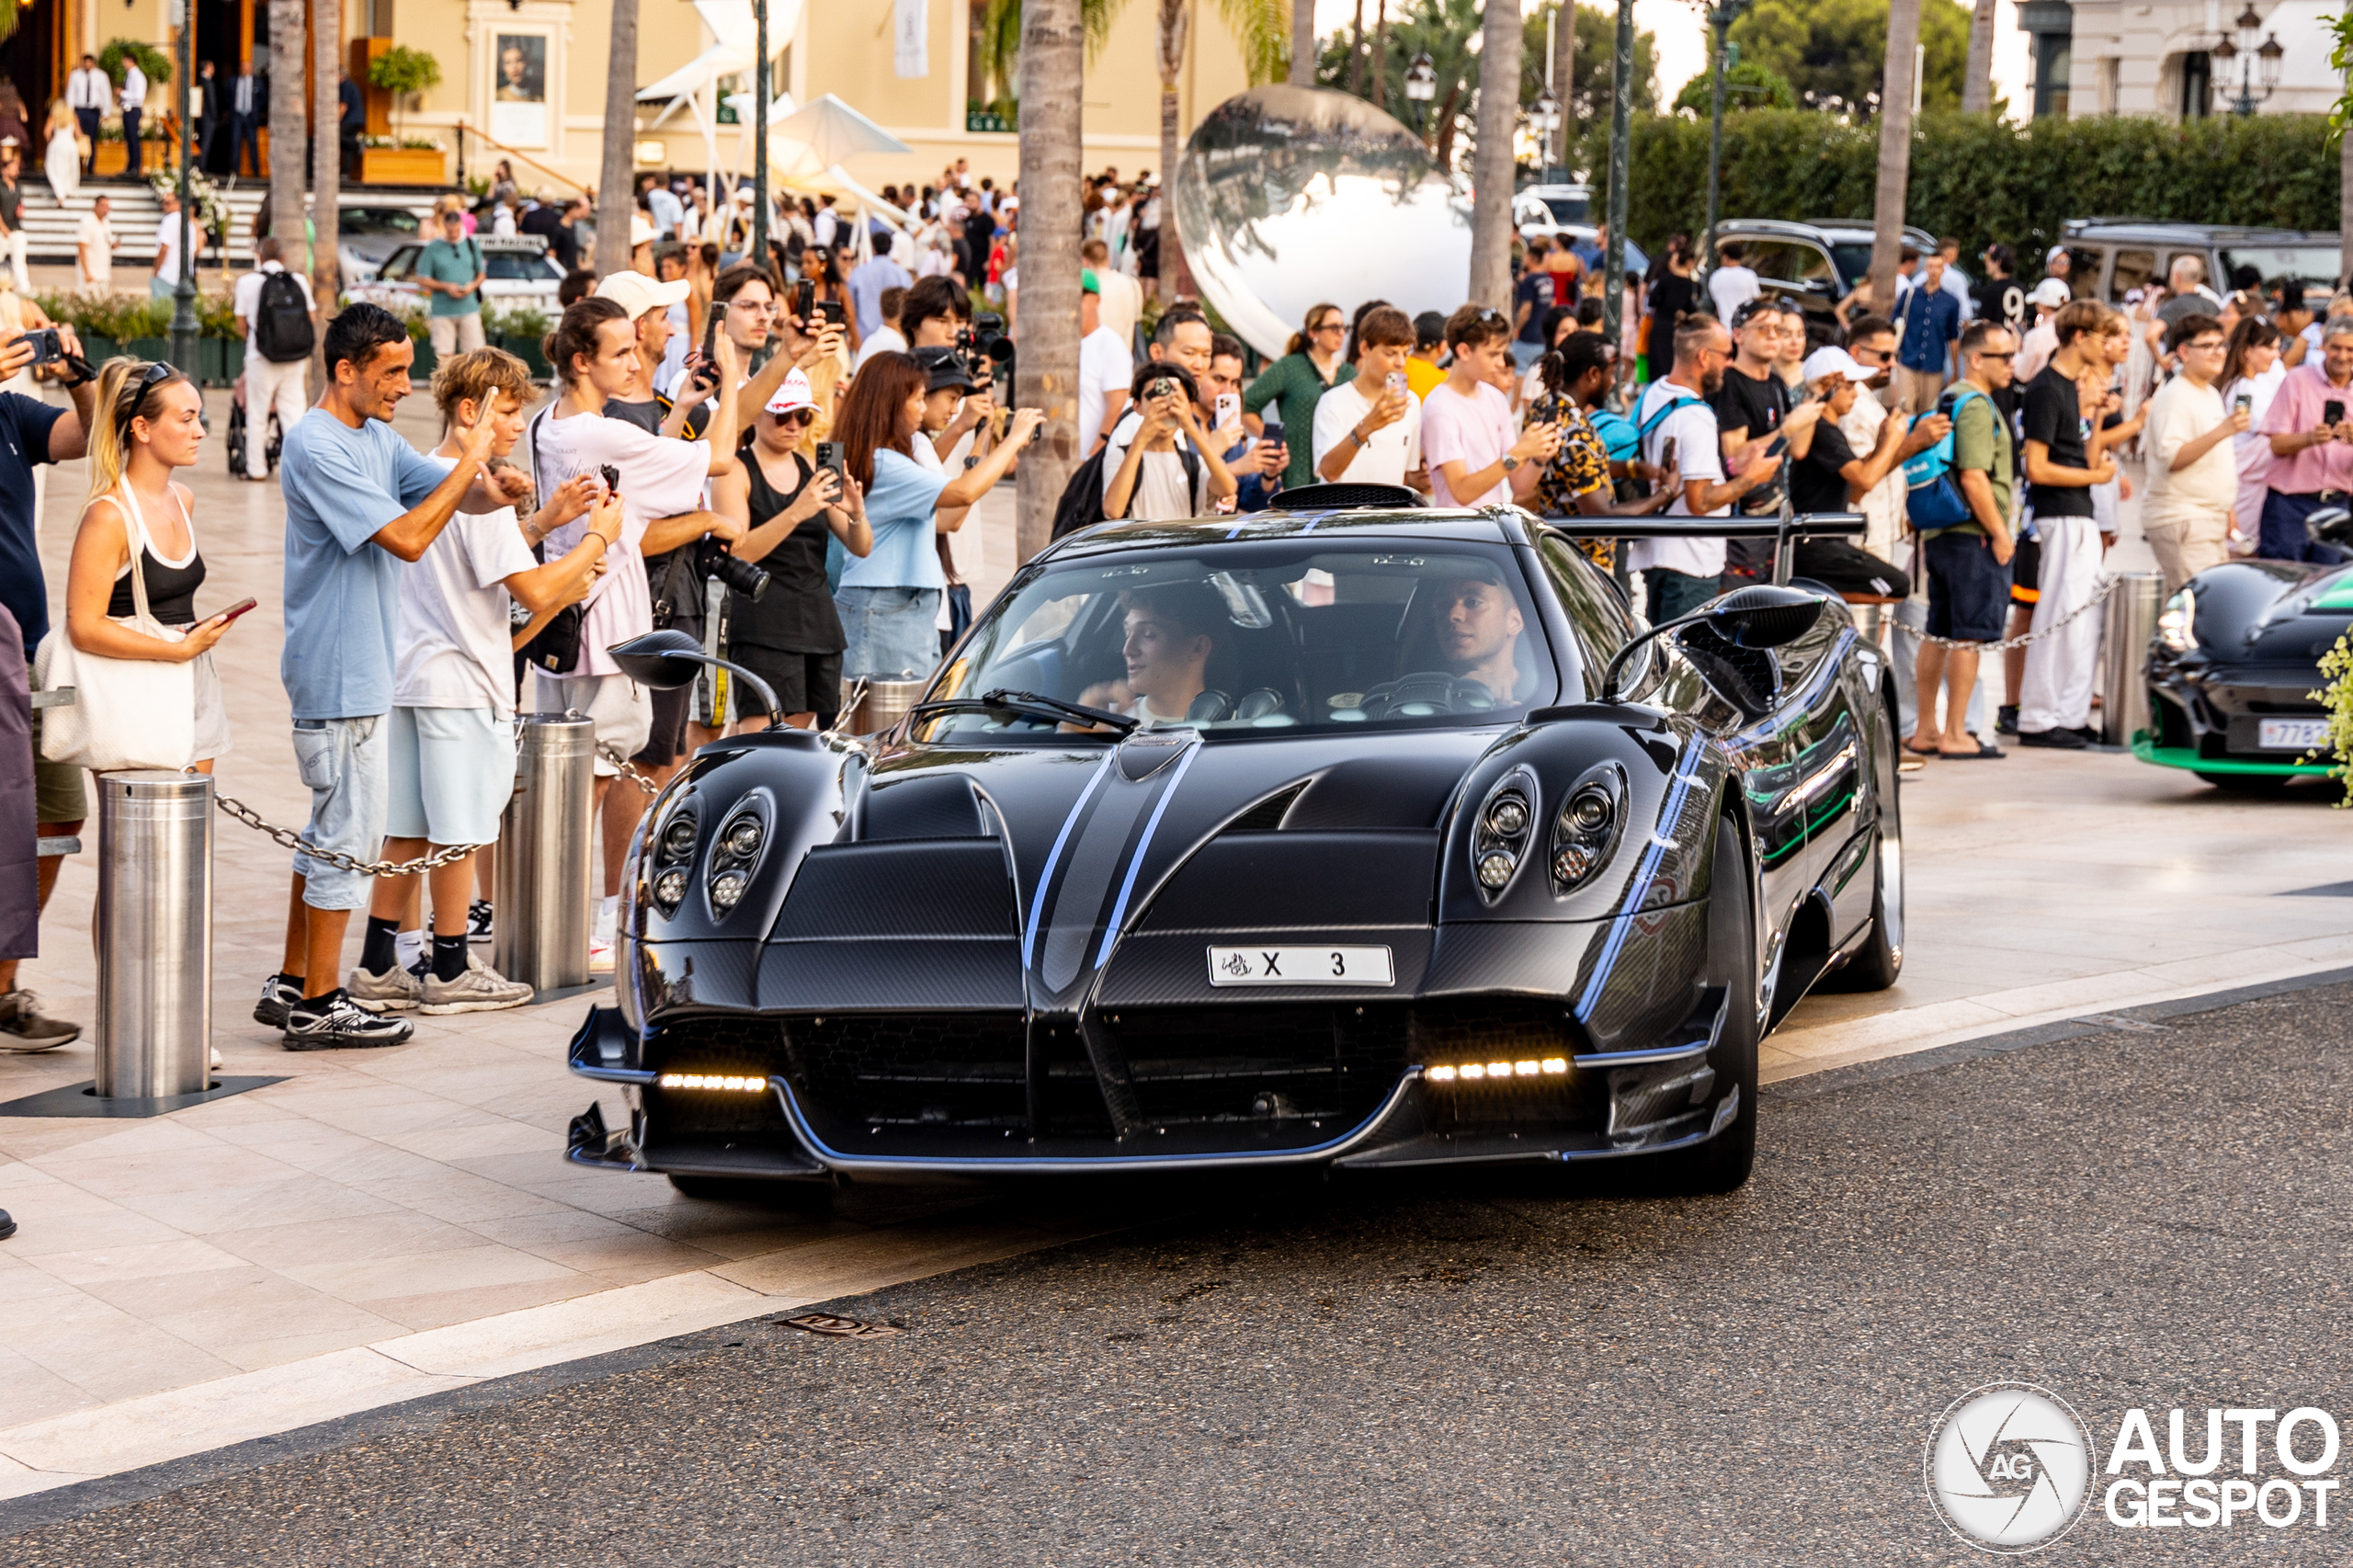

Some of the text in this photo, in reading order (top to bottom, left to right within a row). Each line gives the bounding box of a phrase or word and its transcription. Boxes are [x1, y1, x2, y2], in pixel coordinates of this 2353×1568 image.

[2003, 286, 2025, 329] 9
[1261, 951, 1282, 977] X
[1330, 952, 1346, 976] 3
